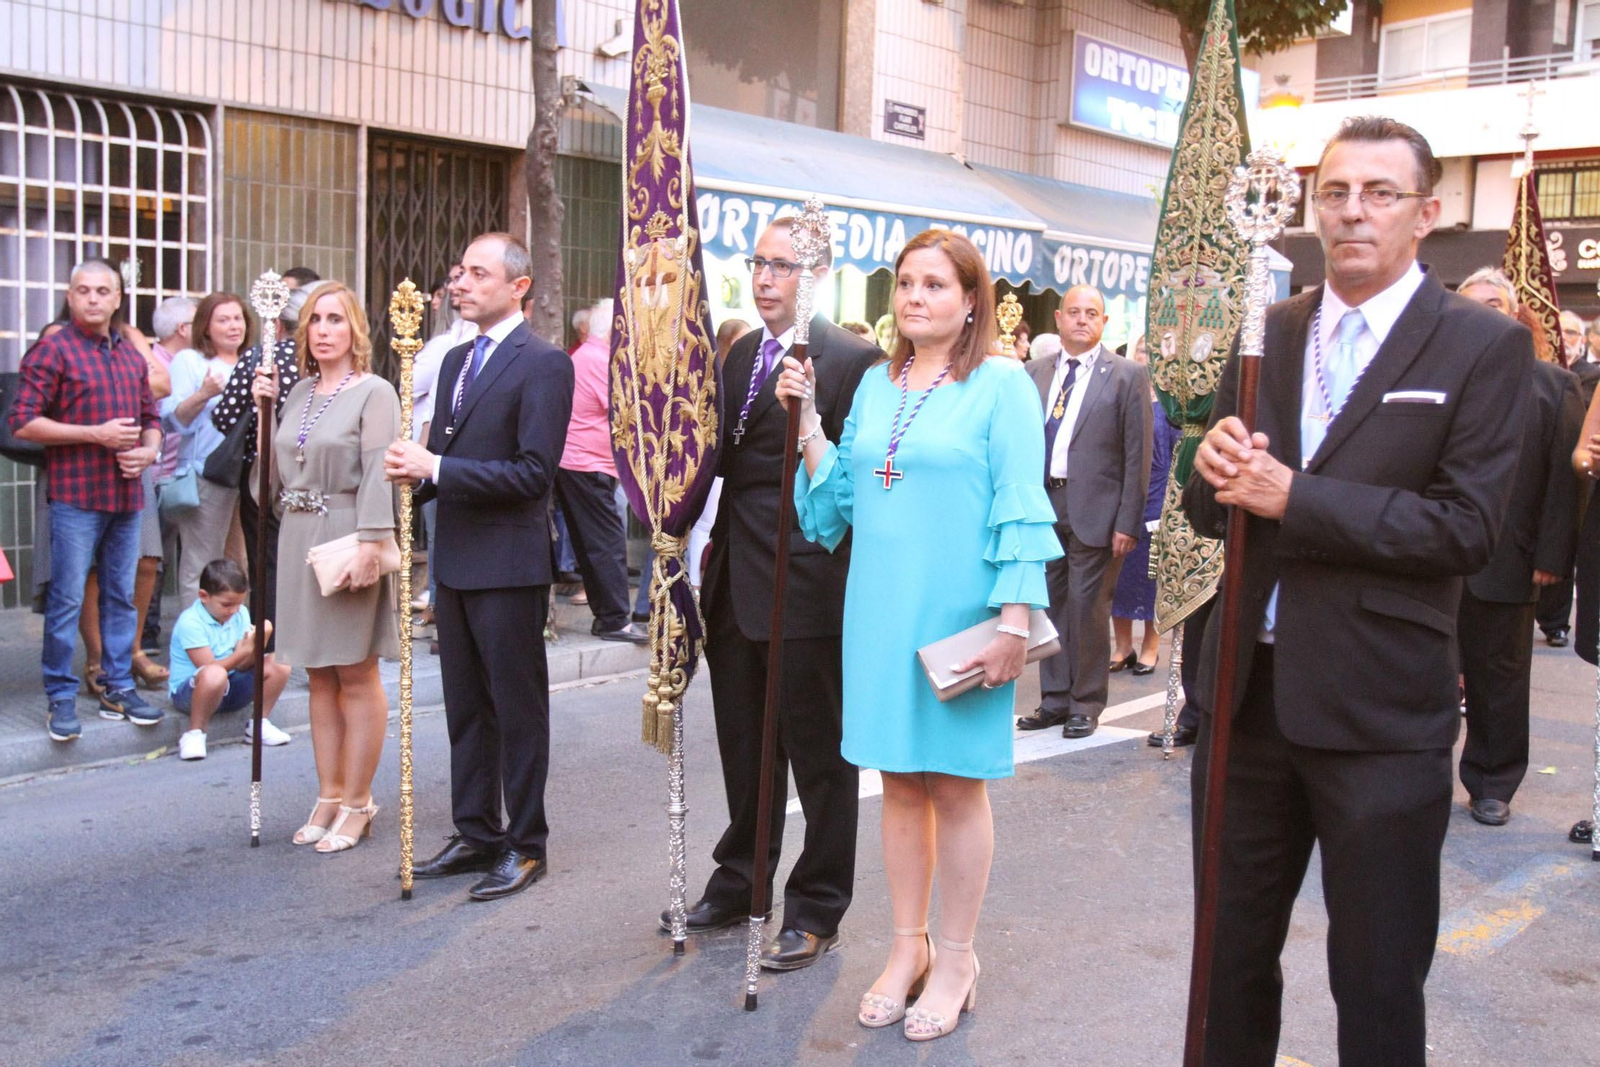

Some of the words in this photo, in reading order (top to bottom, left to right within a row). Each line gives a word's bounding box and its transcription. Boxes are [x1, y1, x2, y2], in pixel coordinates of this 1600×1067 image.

[1085, 43, 1190, 101] ORTOPE
[697, 193, 905, 263] ORTEDIA
[1054, 245, 1150, 293] ORTOPE
